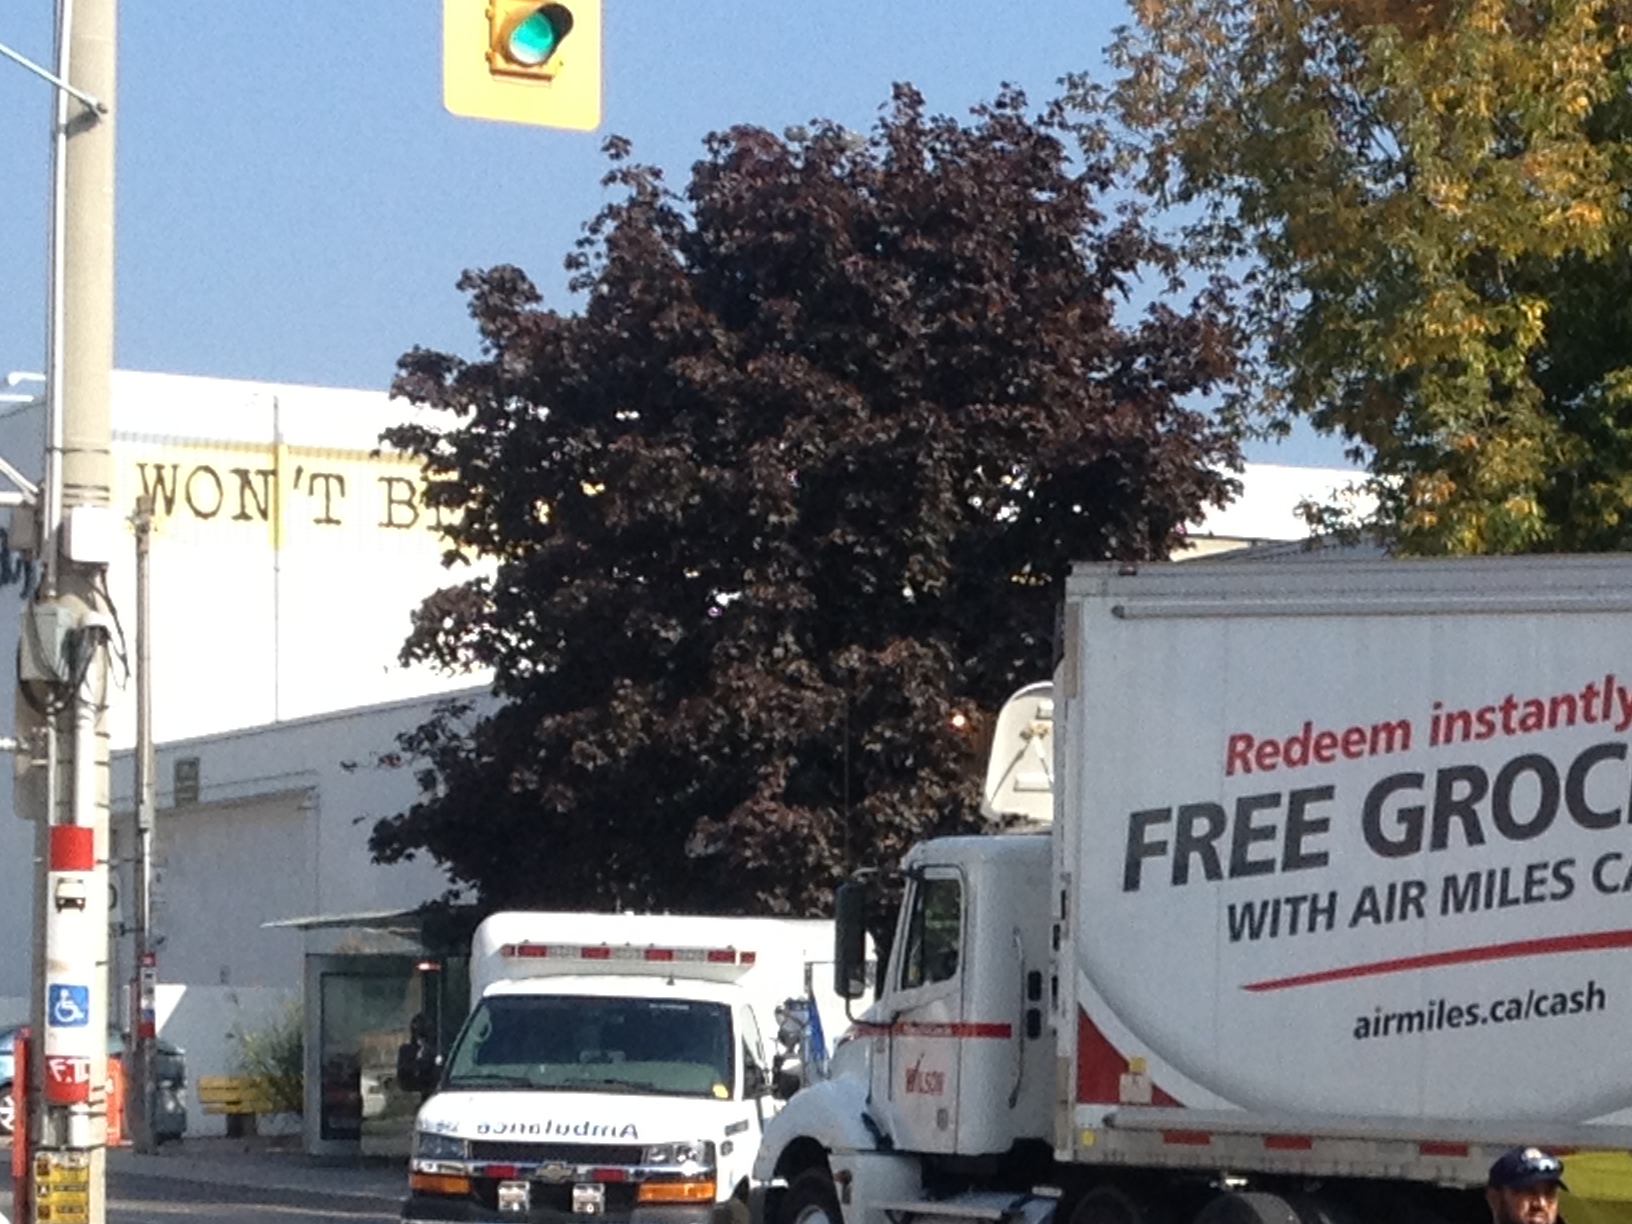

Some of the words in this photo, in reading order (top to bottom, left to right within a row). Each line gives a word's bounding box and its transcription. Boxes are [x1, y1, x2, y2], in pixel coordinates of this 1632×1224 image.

[136, 463, 346, 525] WON'T
[1224, 716, 1412, 777] Redeem
[1123, 785, 1335, 892] FREE
[1226, 891, 1337, 943] WITH
[1349, 878, 1426, 929] AIR
[1439, 857, 1576, 916] MILES
[1352, 982, 1607, 1041] airmiles.ca/cash
